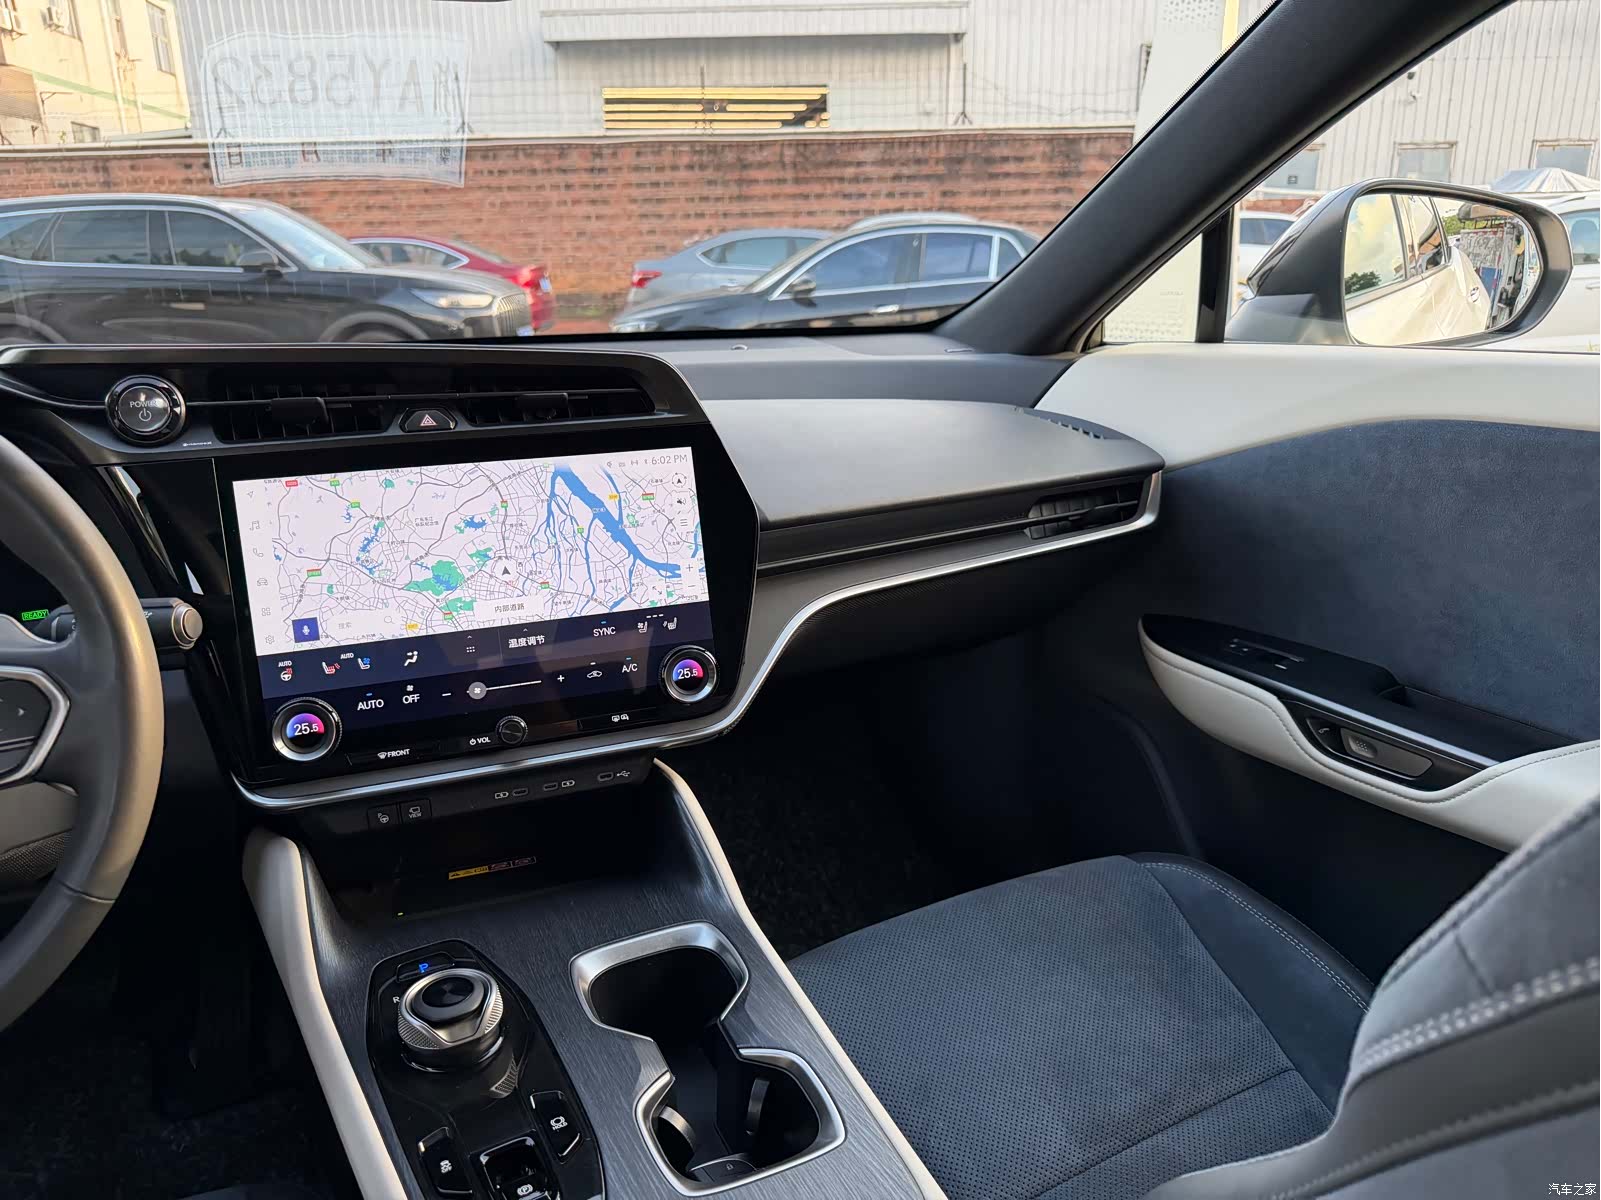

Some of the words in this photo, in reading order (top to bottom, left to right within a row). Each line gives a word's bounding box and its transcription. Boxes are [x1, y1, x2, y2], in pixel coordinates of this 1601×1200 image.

[651, 455, 672, 465] 6:02
[673, 454, 688, 463] PM
[494, 602, 525, 613] 内部道路
[24, 610, 48, 620] READY
[593, 626, 616, 637] SYNC
[508, 634, 546, 649] 温度调节
[340, 652, 354, 660] AUTO
[621, 663, 638, 673] A/C
[677, 667, 699, 680] 25.5
[402, 693, 421, 704] OFF
[356, 698, 385, 711] AUTO
[293, 722, 319, 736] 25.5
[477, 736, 491, 744] VOL
[387, 748, 411, 759] FRONT
[418, 962, 429, 974] P
[392, 996, 401, 1004] R
